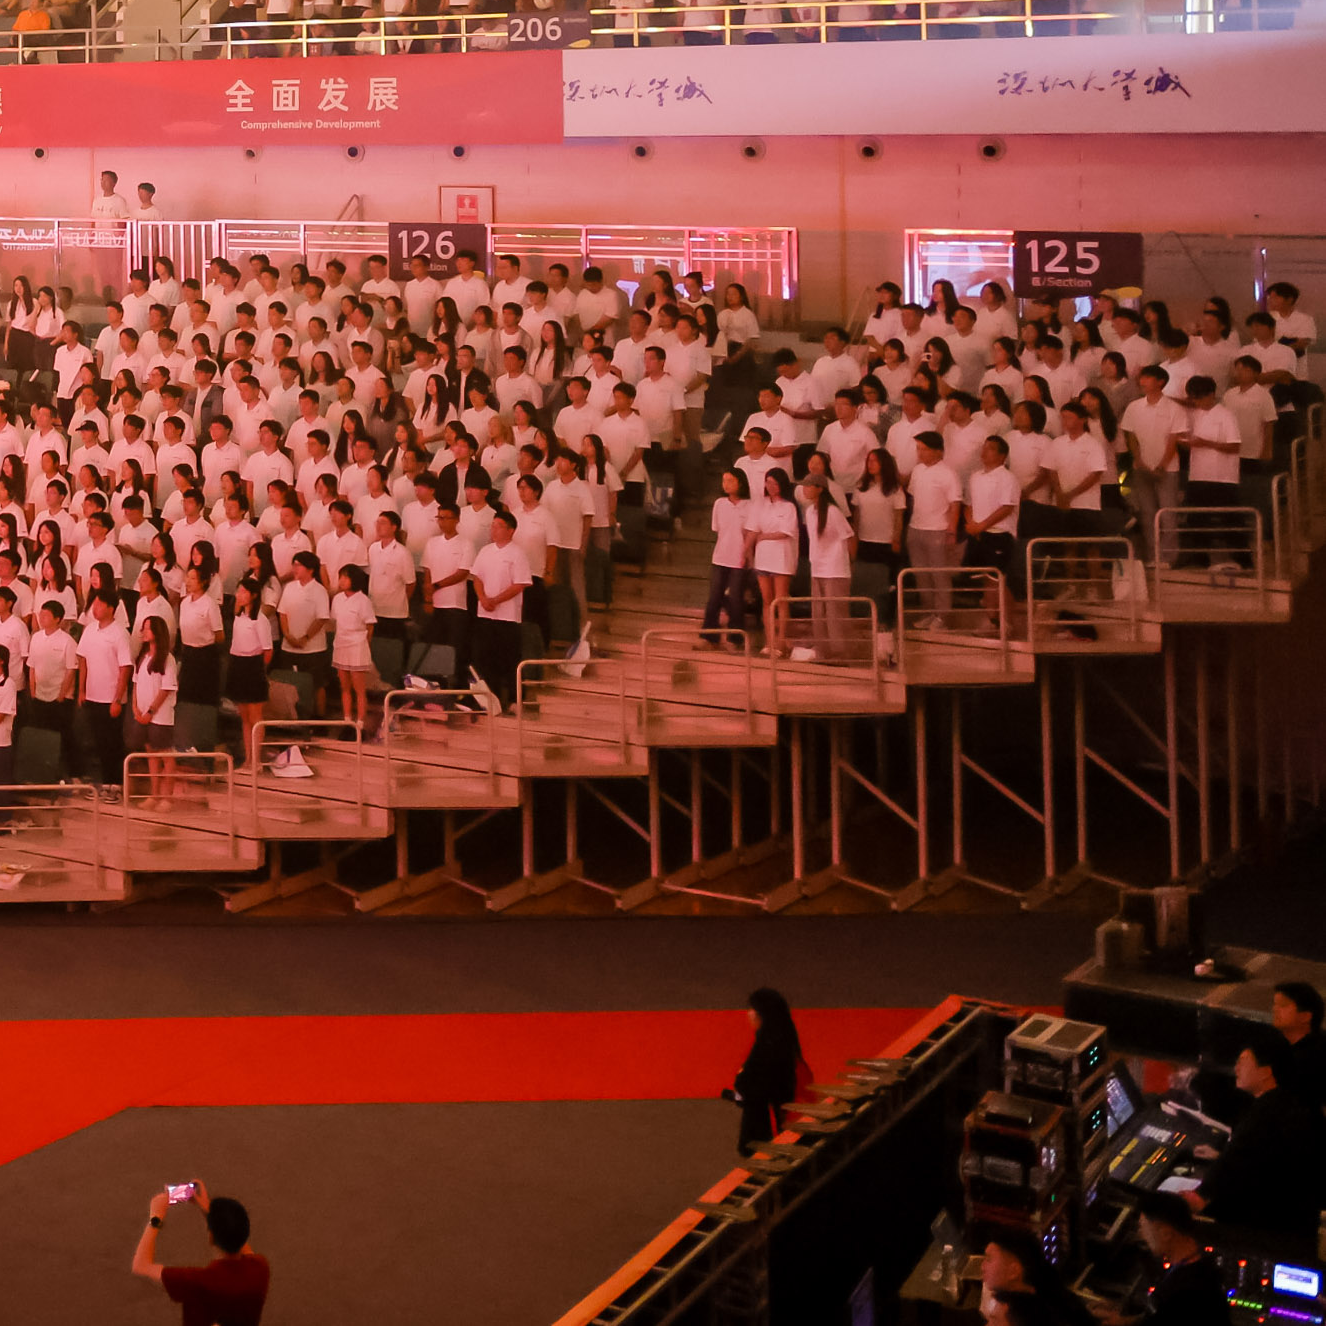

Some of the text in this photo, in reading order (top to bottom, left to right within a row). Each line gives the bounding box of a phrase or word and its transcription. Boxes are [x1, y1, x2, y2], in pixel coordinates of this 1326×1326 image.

[509, 17, 562, 42] 206
[225, 77, 399, 112] 全面发展
[240, 119, 381, 131] Comprehensive Development
[398, 230, 456, 260] 126
[1026, 239, 1100, 274] 125
[1032, 277, 1092, 288] 区/Section
